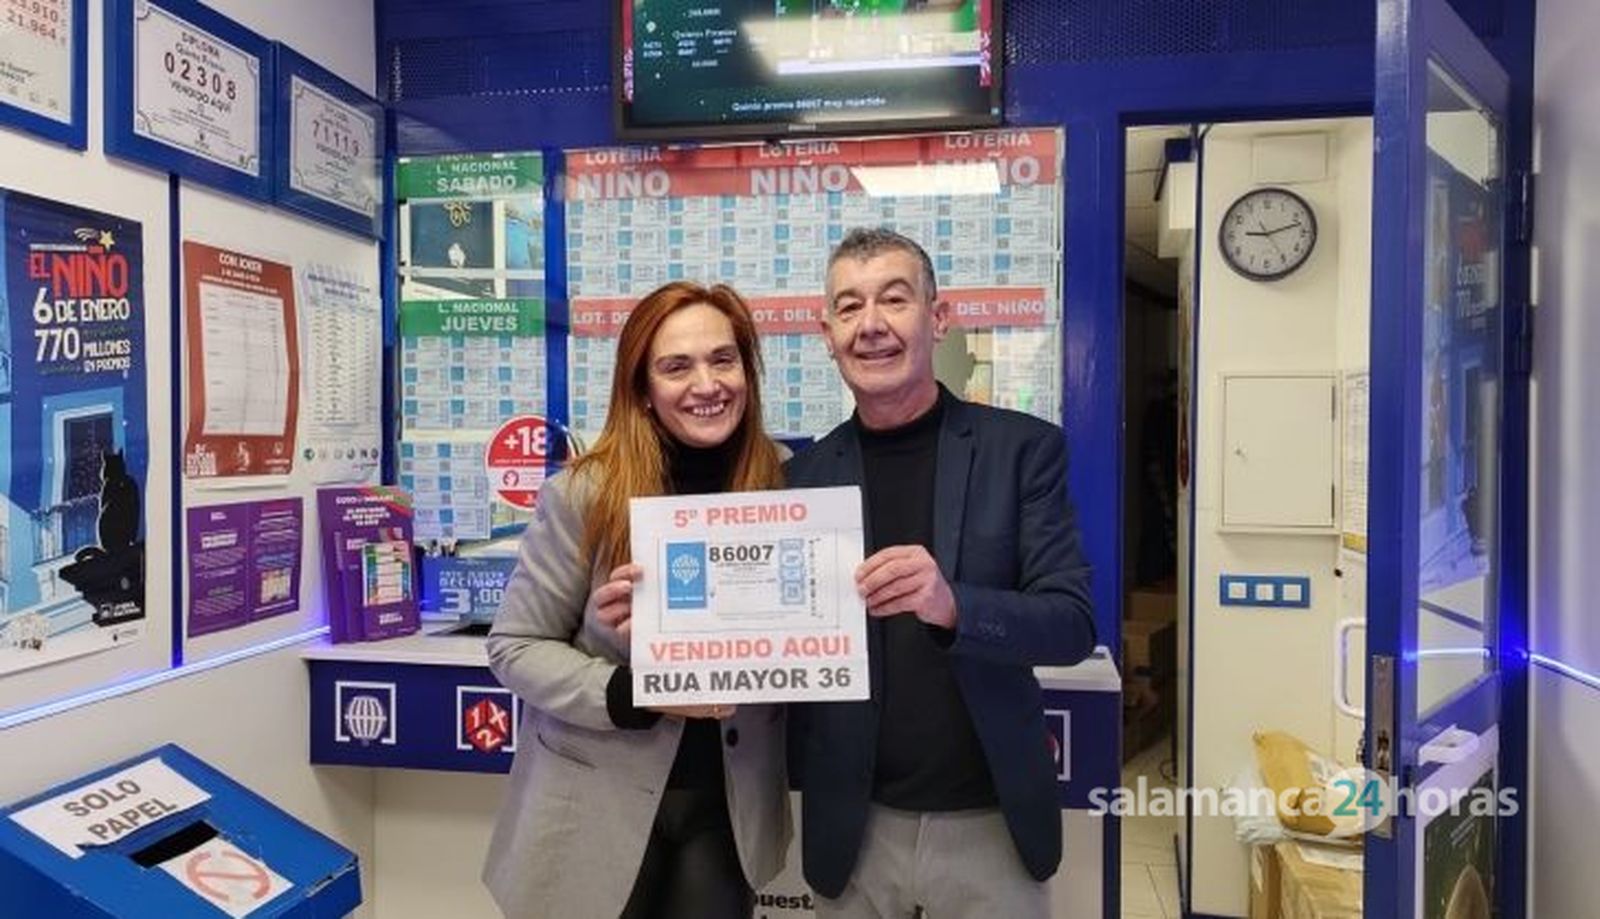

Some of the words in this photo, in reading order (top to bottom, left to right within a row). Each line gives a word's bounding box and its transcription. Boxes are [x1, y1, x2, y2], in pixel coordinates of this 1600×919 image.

[164, 51, 236, 100] 02308
[759, 140, 840, 159] LOTERIA
[944, 132, 1033, 149] LOTERIA
[585, 146, 664, 165] LOTERIA
[451, 159, 518, 174] NACIONAL
[436, 174, 517, 193] SABADO
[750, 159, 849, 196] NIÑO
[29, 251, 51, 279] EL
[52, 245, 129, 300] NIÑO
[32, 286, 54, 324] 6
[54, 299, 78, 324] DE
[80, 296, 131, 322] ENERO
[453, 301, 519, 314] NACIONAL
[956, 302, 994, 317] DEL
[998, 299, 1044, 316] NIÑO
[440, 315, 518, 332] JUEVES
[752, 309, 779, 322] OT.
[34, 326, 80, 362] 770
[83, 339, 131, 359] MILLONES
[706, 502, 808, 526] PREMIO
[708, 544, 774, 563] 86007
[649, 637, 773, 663] VENDIDO
[781, 635, 851, 659] AQUI
[643, 671, 701, 694] RUA
[710, 668, 809, 692] MAYOR
[818, 667, 852, 689] 36
[62, 778, 142, 818] SOLO
[87, 796, 178, 840] PAPEL
